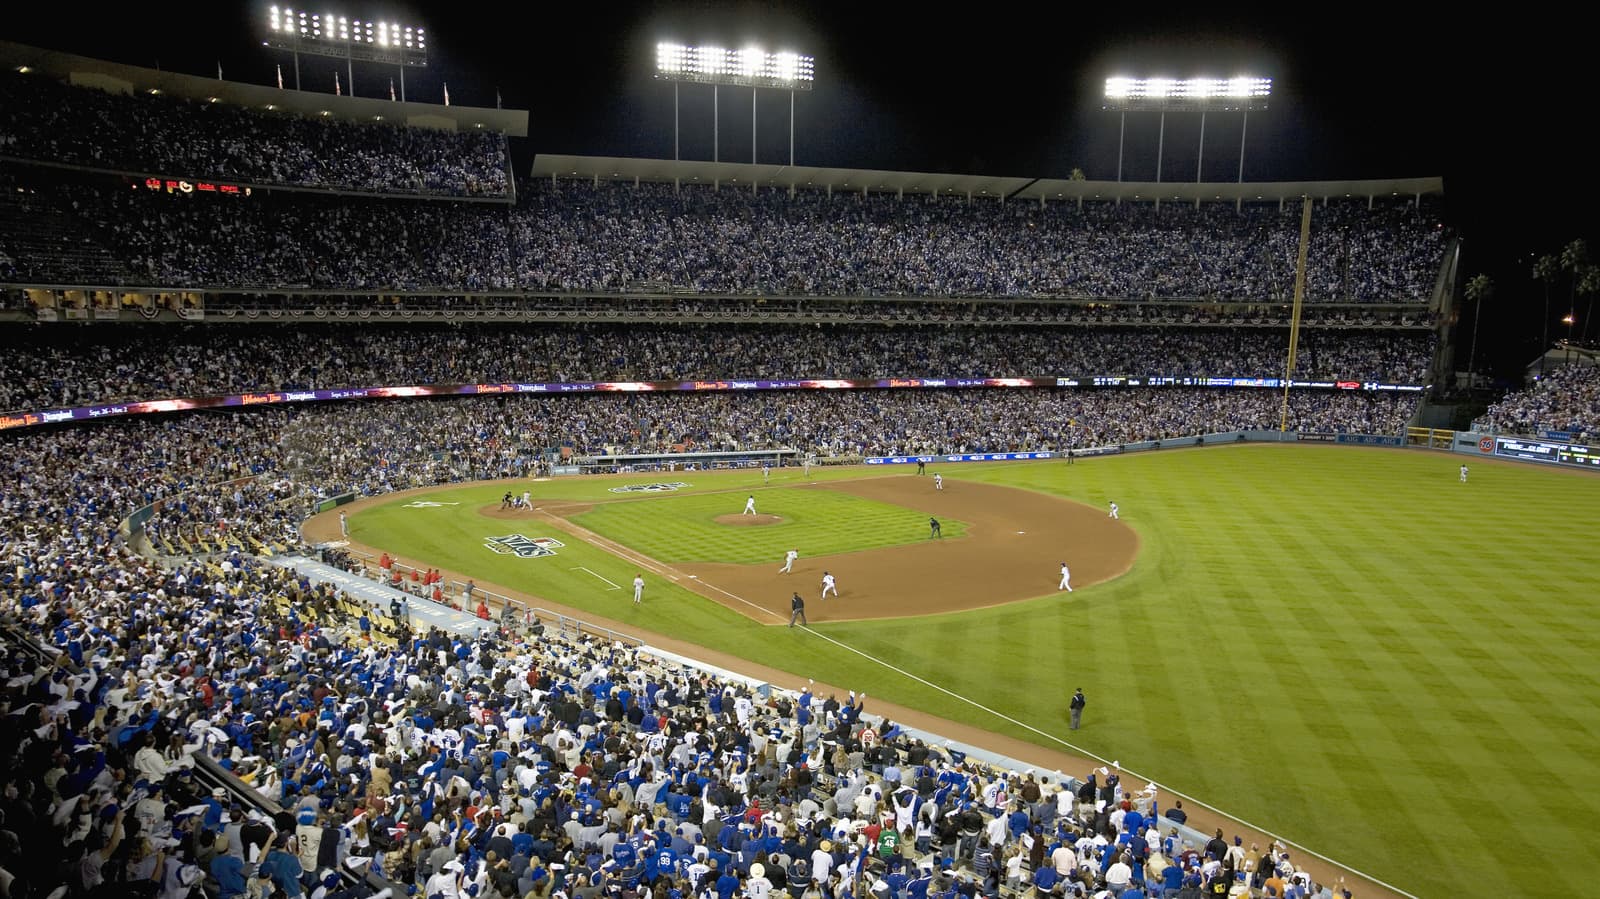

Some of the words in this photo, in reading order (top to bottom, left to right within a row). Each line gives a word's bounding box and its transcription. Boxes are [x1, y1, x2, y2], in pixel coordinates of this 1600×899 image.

[1480, 440, 1491, 449] 76
[301, 834, 308, 847] 2
[660, 857, 671, 866] 99
